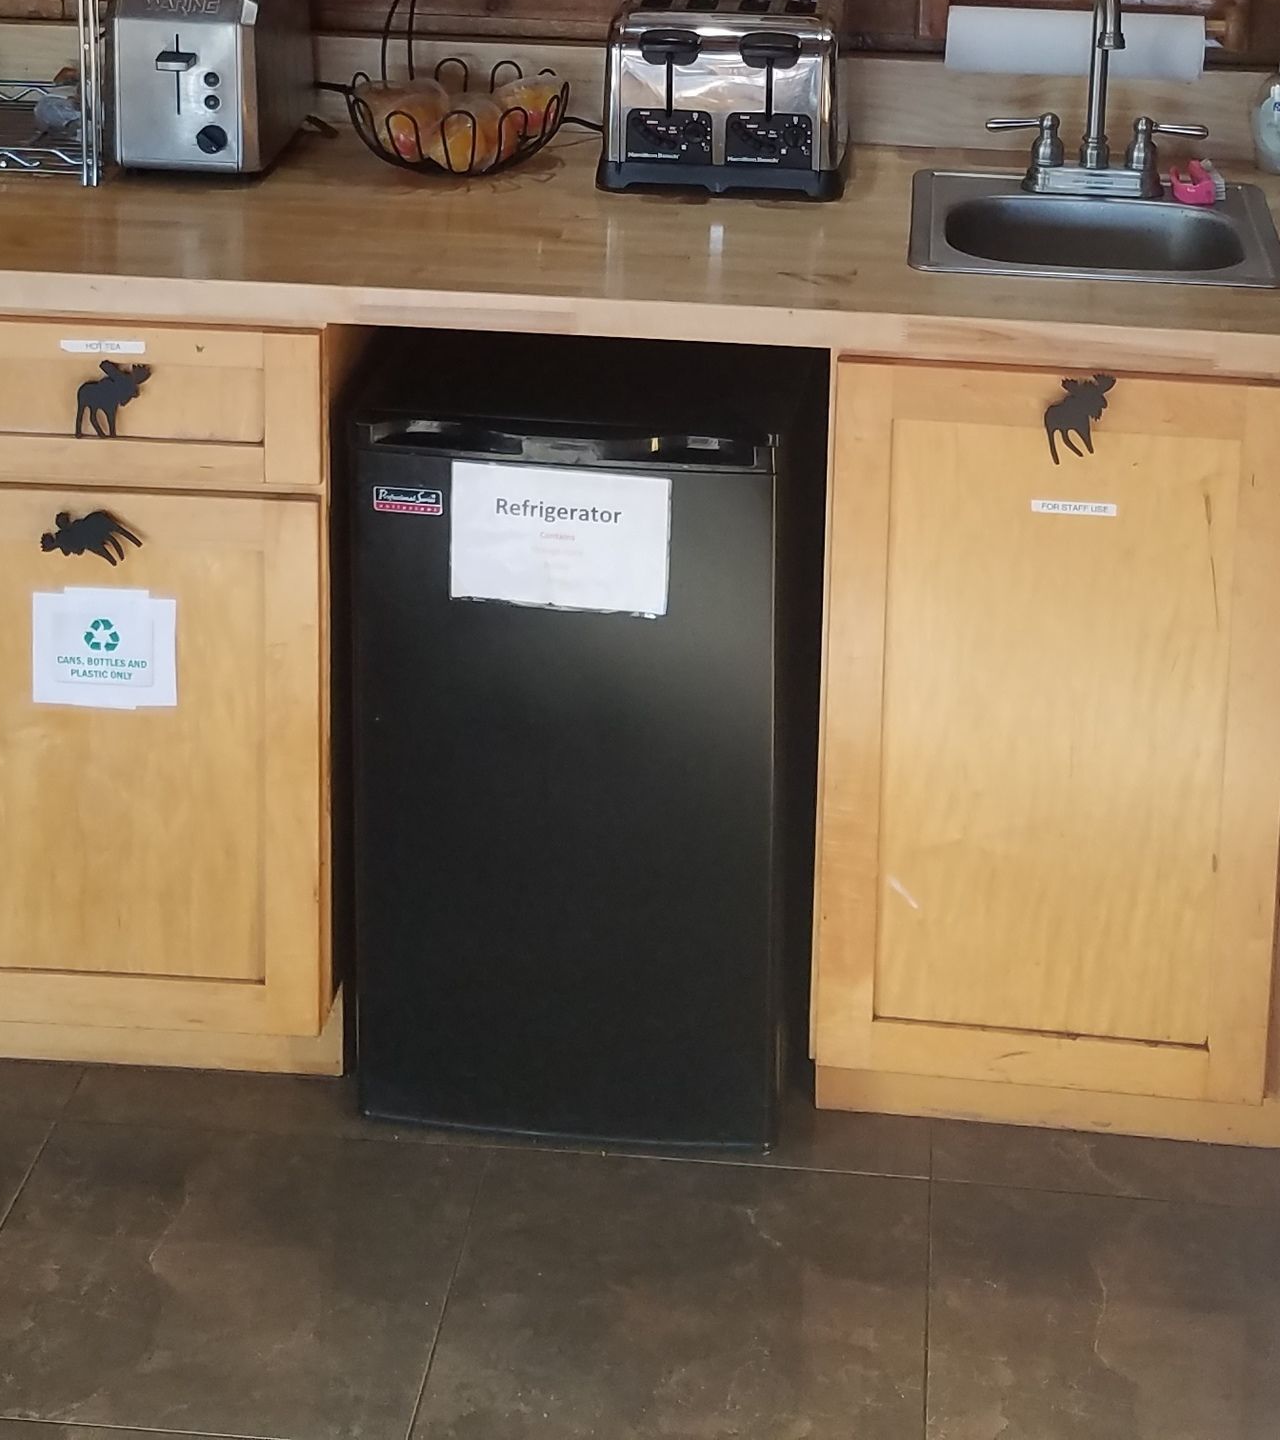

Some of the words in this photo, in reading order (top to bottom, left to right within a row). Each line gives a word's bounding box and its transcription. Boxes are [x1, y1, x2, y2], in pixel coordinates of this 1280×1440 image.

[105, 343, 121, 351] TEA
[496, 498, 622, 524] Refrigerator
[1041, 503, 1060, 511] FOR
[1061, 504, 1089, 512] STAFF
[87, 657, 126, 668] BOTTLES
[127, 659, 148, 669] AND
[70, 669, 109, 679] PLASTIC
[110, 670, 133, 681] ONLY
